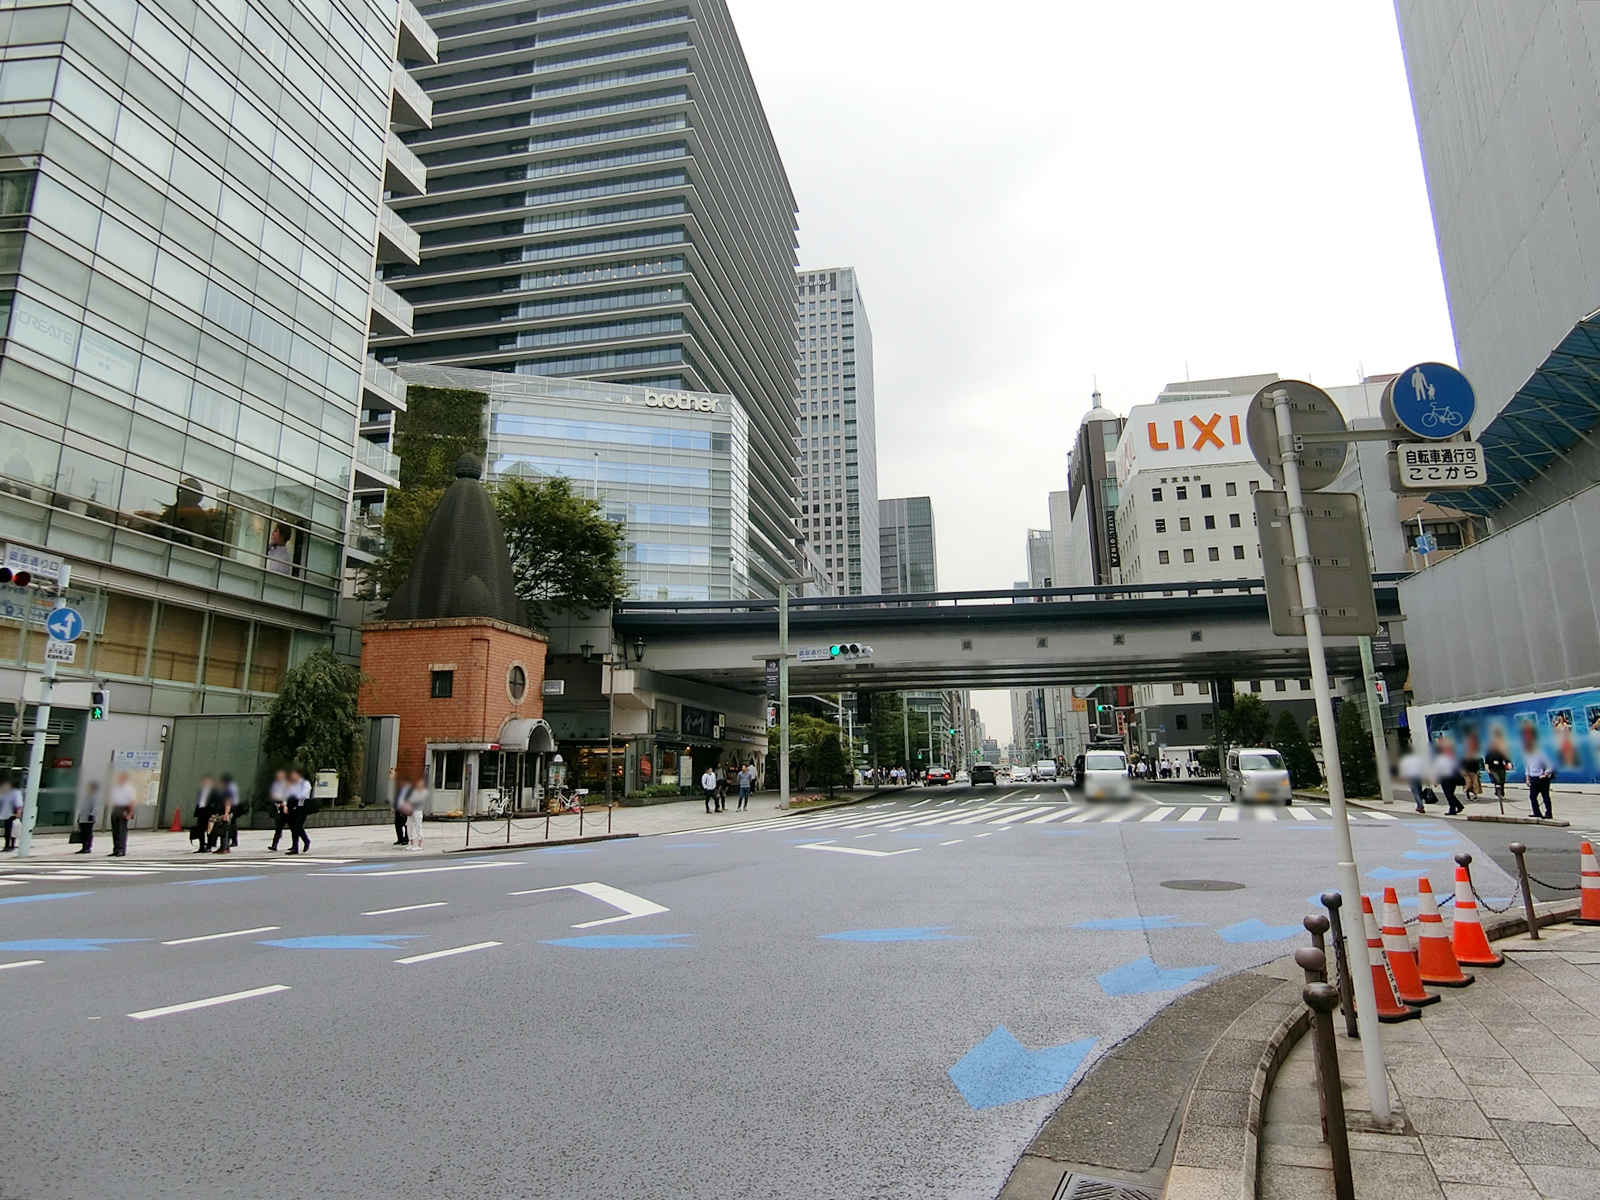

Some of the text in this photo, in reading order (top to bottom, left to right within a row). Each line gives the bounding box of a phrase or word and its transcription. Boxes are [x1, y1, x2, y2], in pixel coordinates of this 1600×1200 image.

[18, 309, 74, 346] CREATE
[644, 388, 719, 413] brother
[1405, 448, 1477, 464] 自転車通行可
[1409, 466, 1478, 480] ここから
[9, 550, 60, 572] 銀座通り口
